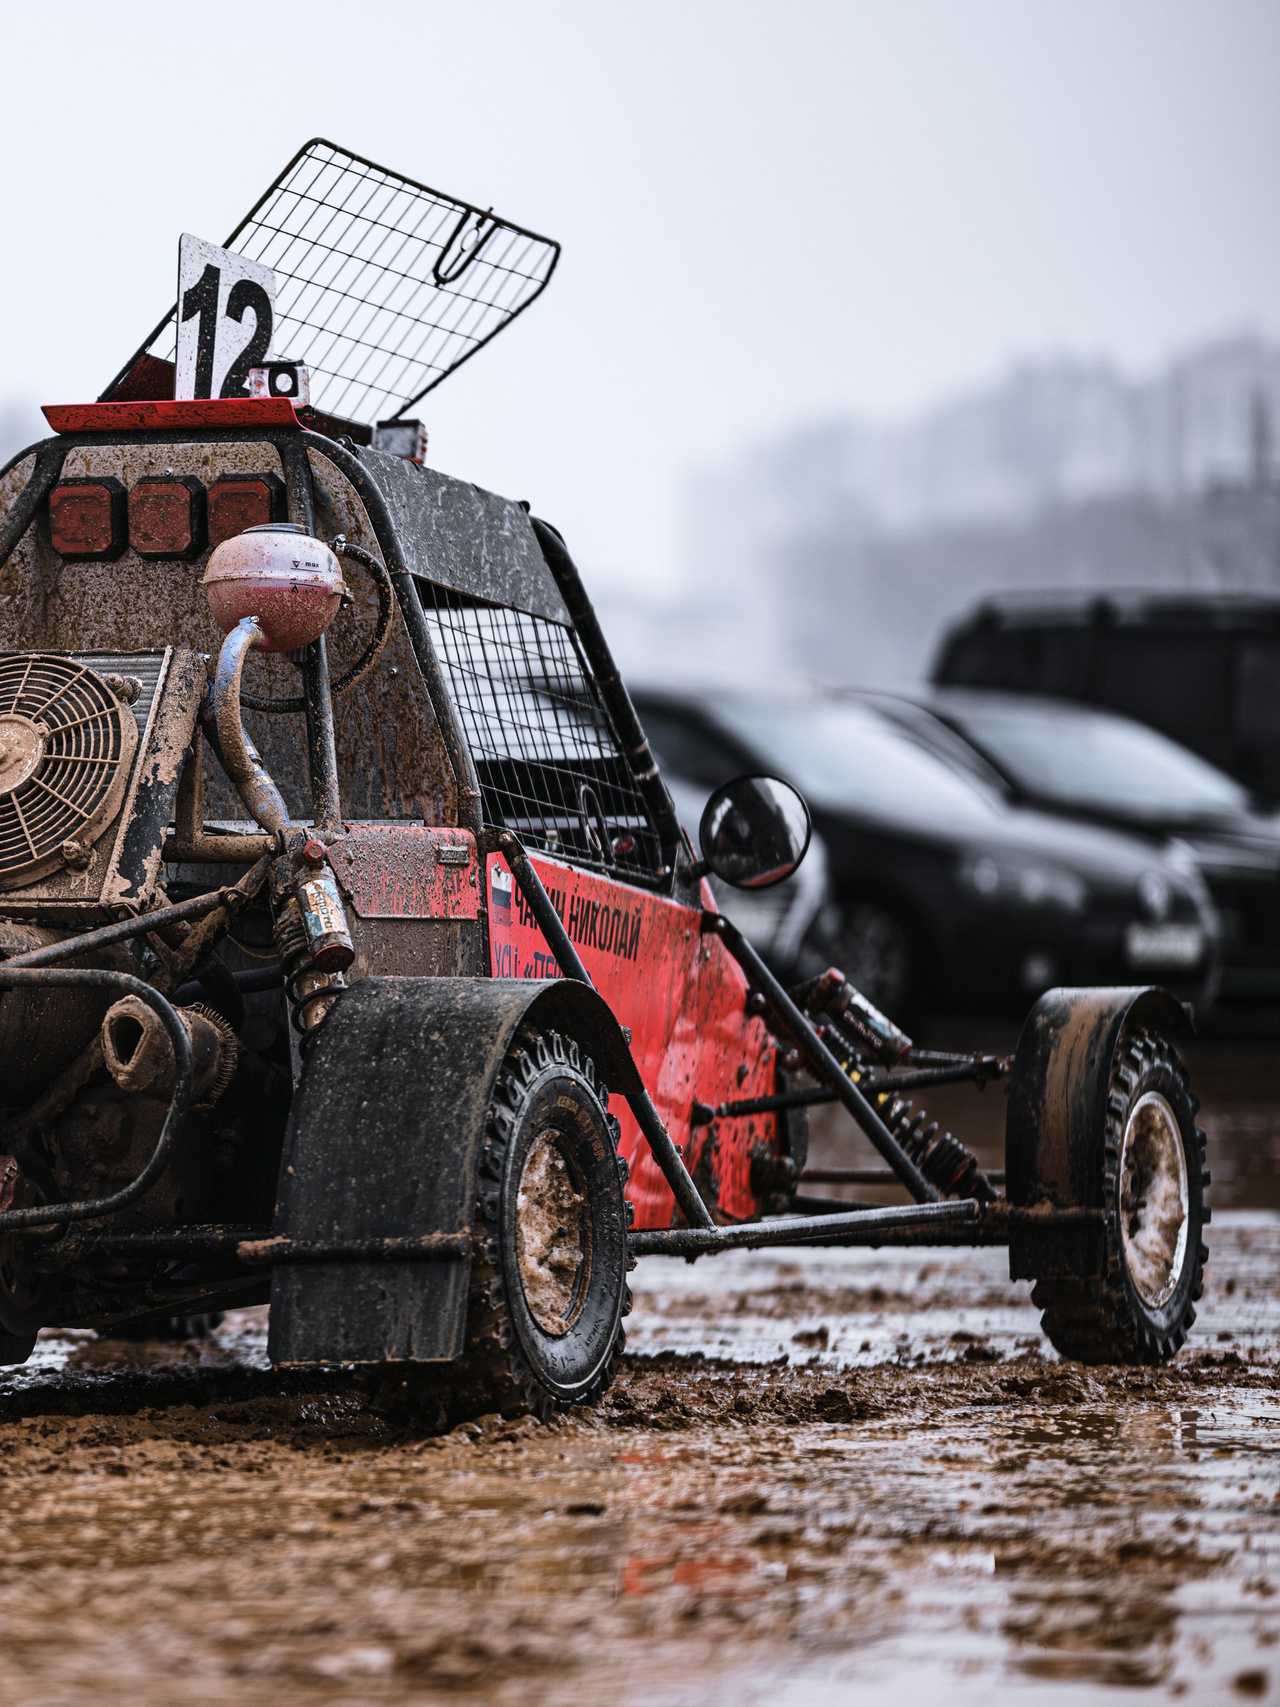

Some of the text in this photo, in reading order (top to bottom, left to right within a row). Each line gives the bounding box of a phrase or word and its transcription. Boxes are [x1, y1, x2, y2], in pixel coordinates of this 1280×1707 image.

[182, 263, 273, 399] 12
[568, 895, 641, 962] НИКОЛАЙ
[556, 1095, 579, 1114] KENDA
